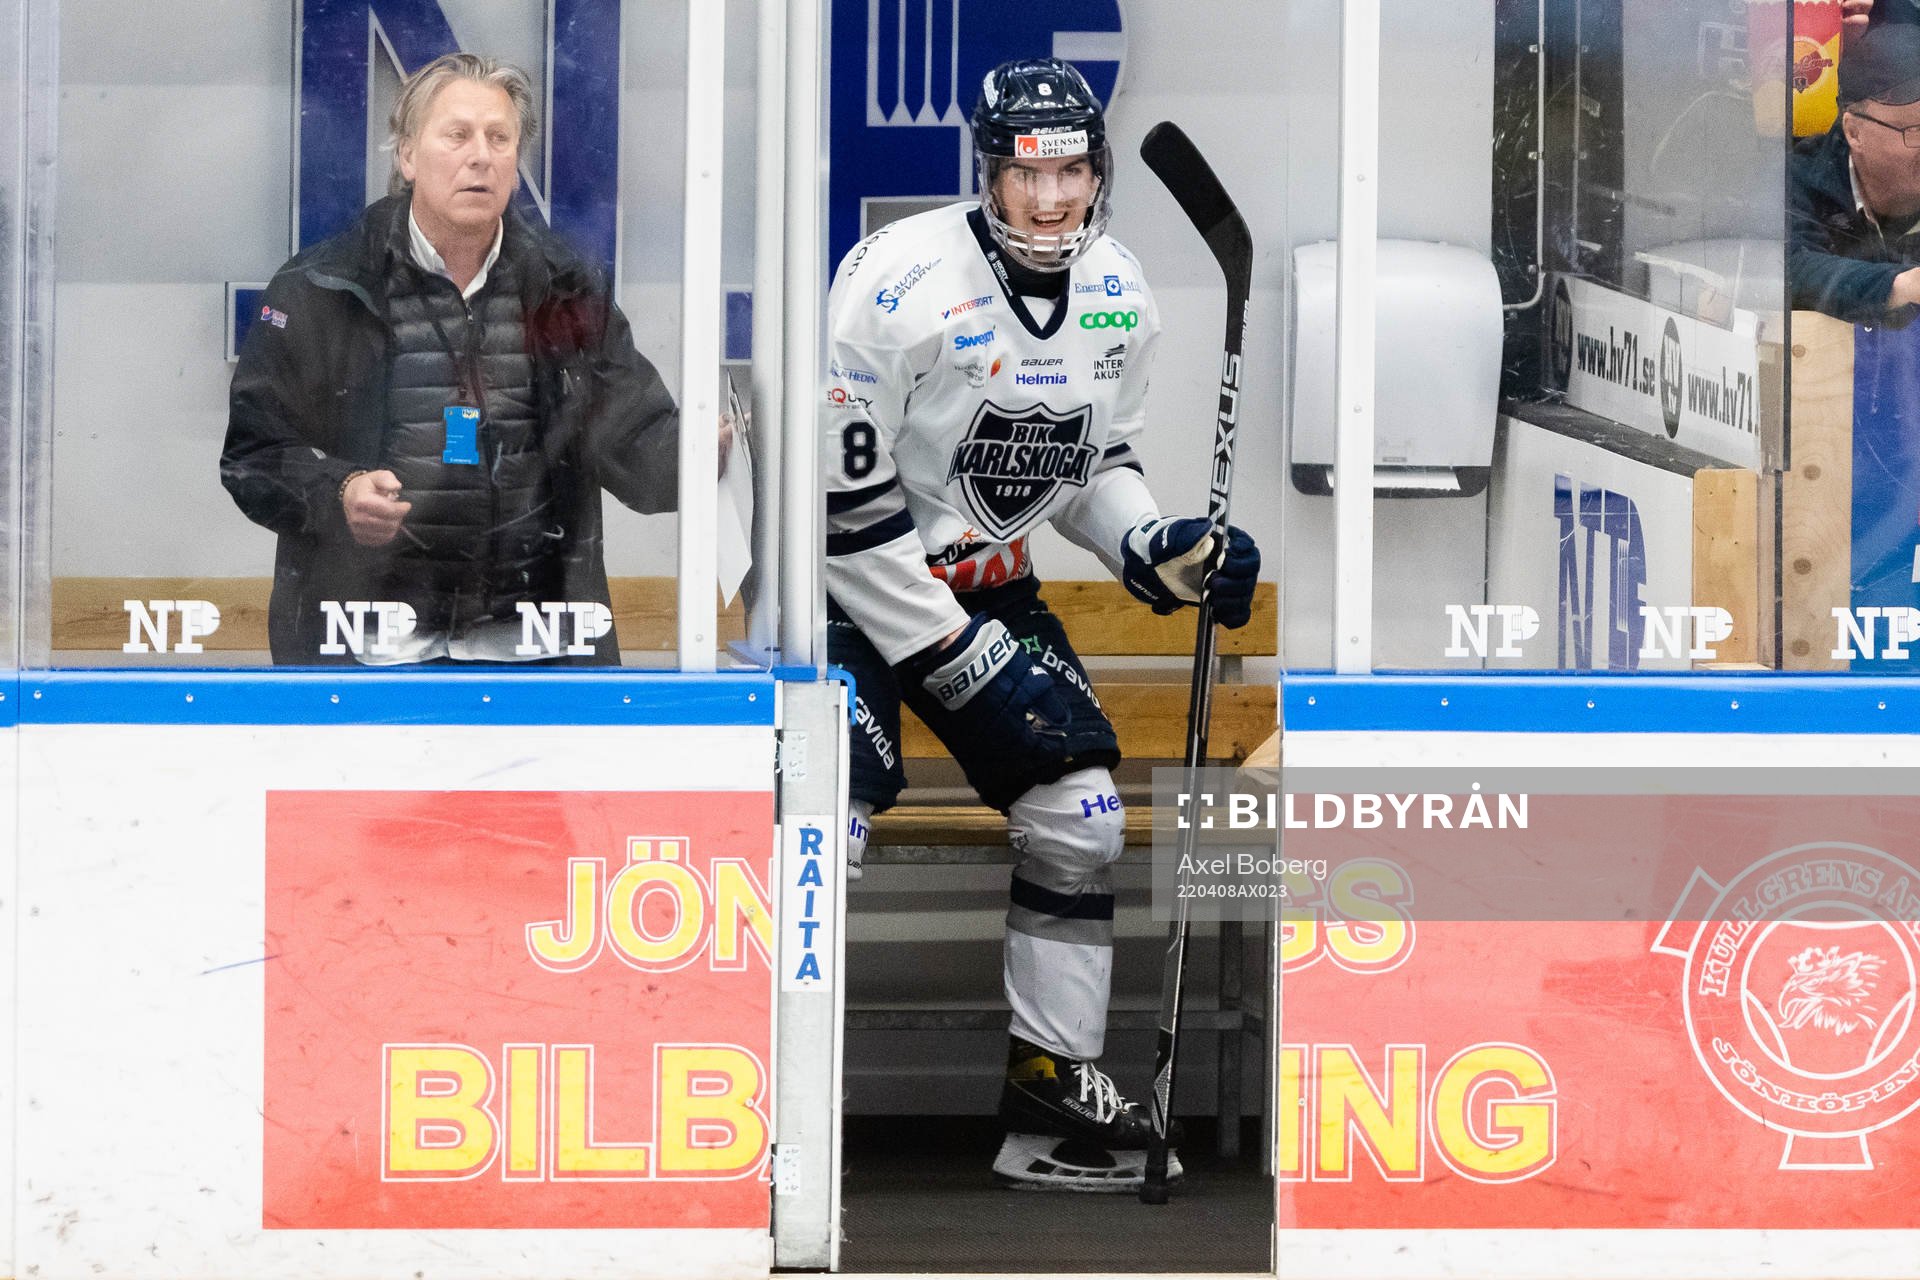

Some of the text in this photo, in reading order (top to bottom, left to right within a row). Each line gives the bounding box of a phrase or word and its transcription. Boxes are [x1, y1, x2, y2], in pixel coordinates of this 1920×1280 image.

[1041, 136, 1086, 147] SVENSKA
[1041, 148, 1066, 156] SPEL
[892, 263, 921, 294] AUTO
[1079, 311, 1139, 332] coop
[1015, 373, 1068, 386] Helmia
[1577, 326, 1655, 396] www.hv71.se
[842, 421, 877, 480] 8
[1009, 422, 1055, 443] BIK
[950, 442, 1093, 481] KARLSKOGA
[995, 485, 1032, 497] 1978
[123, 600, 221, 654] NP
[319, 600, 417, 655] NP
[515, 601, 613, 656] NP
[1444, 604, 1541, 658] NP
[1639, 606, 1735, 660] NP
[1831, 607, 1920, 660] NP
[1042, 646, 1108, 719] bravid
[855, 695, 895, 770] ravida
[795, 827, 824, 980] RAITA
[1698, 860, 1885, 997] KULLGRENS
[381, 1043, 774, 1182] BILB
